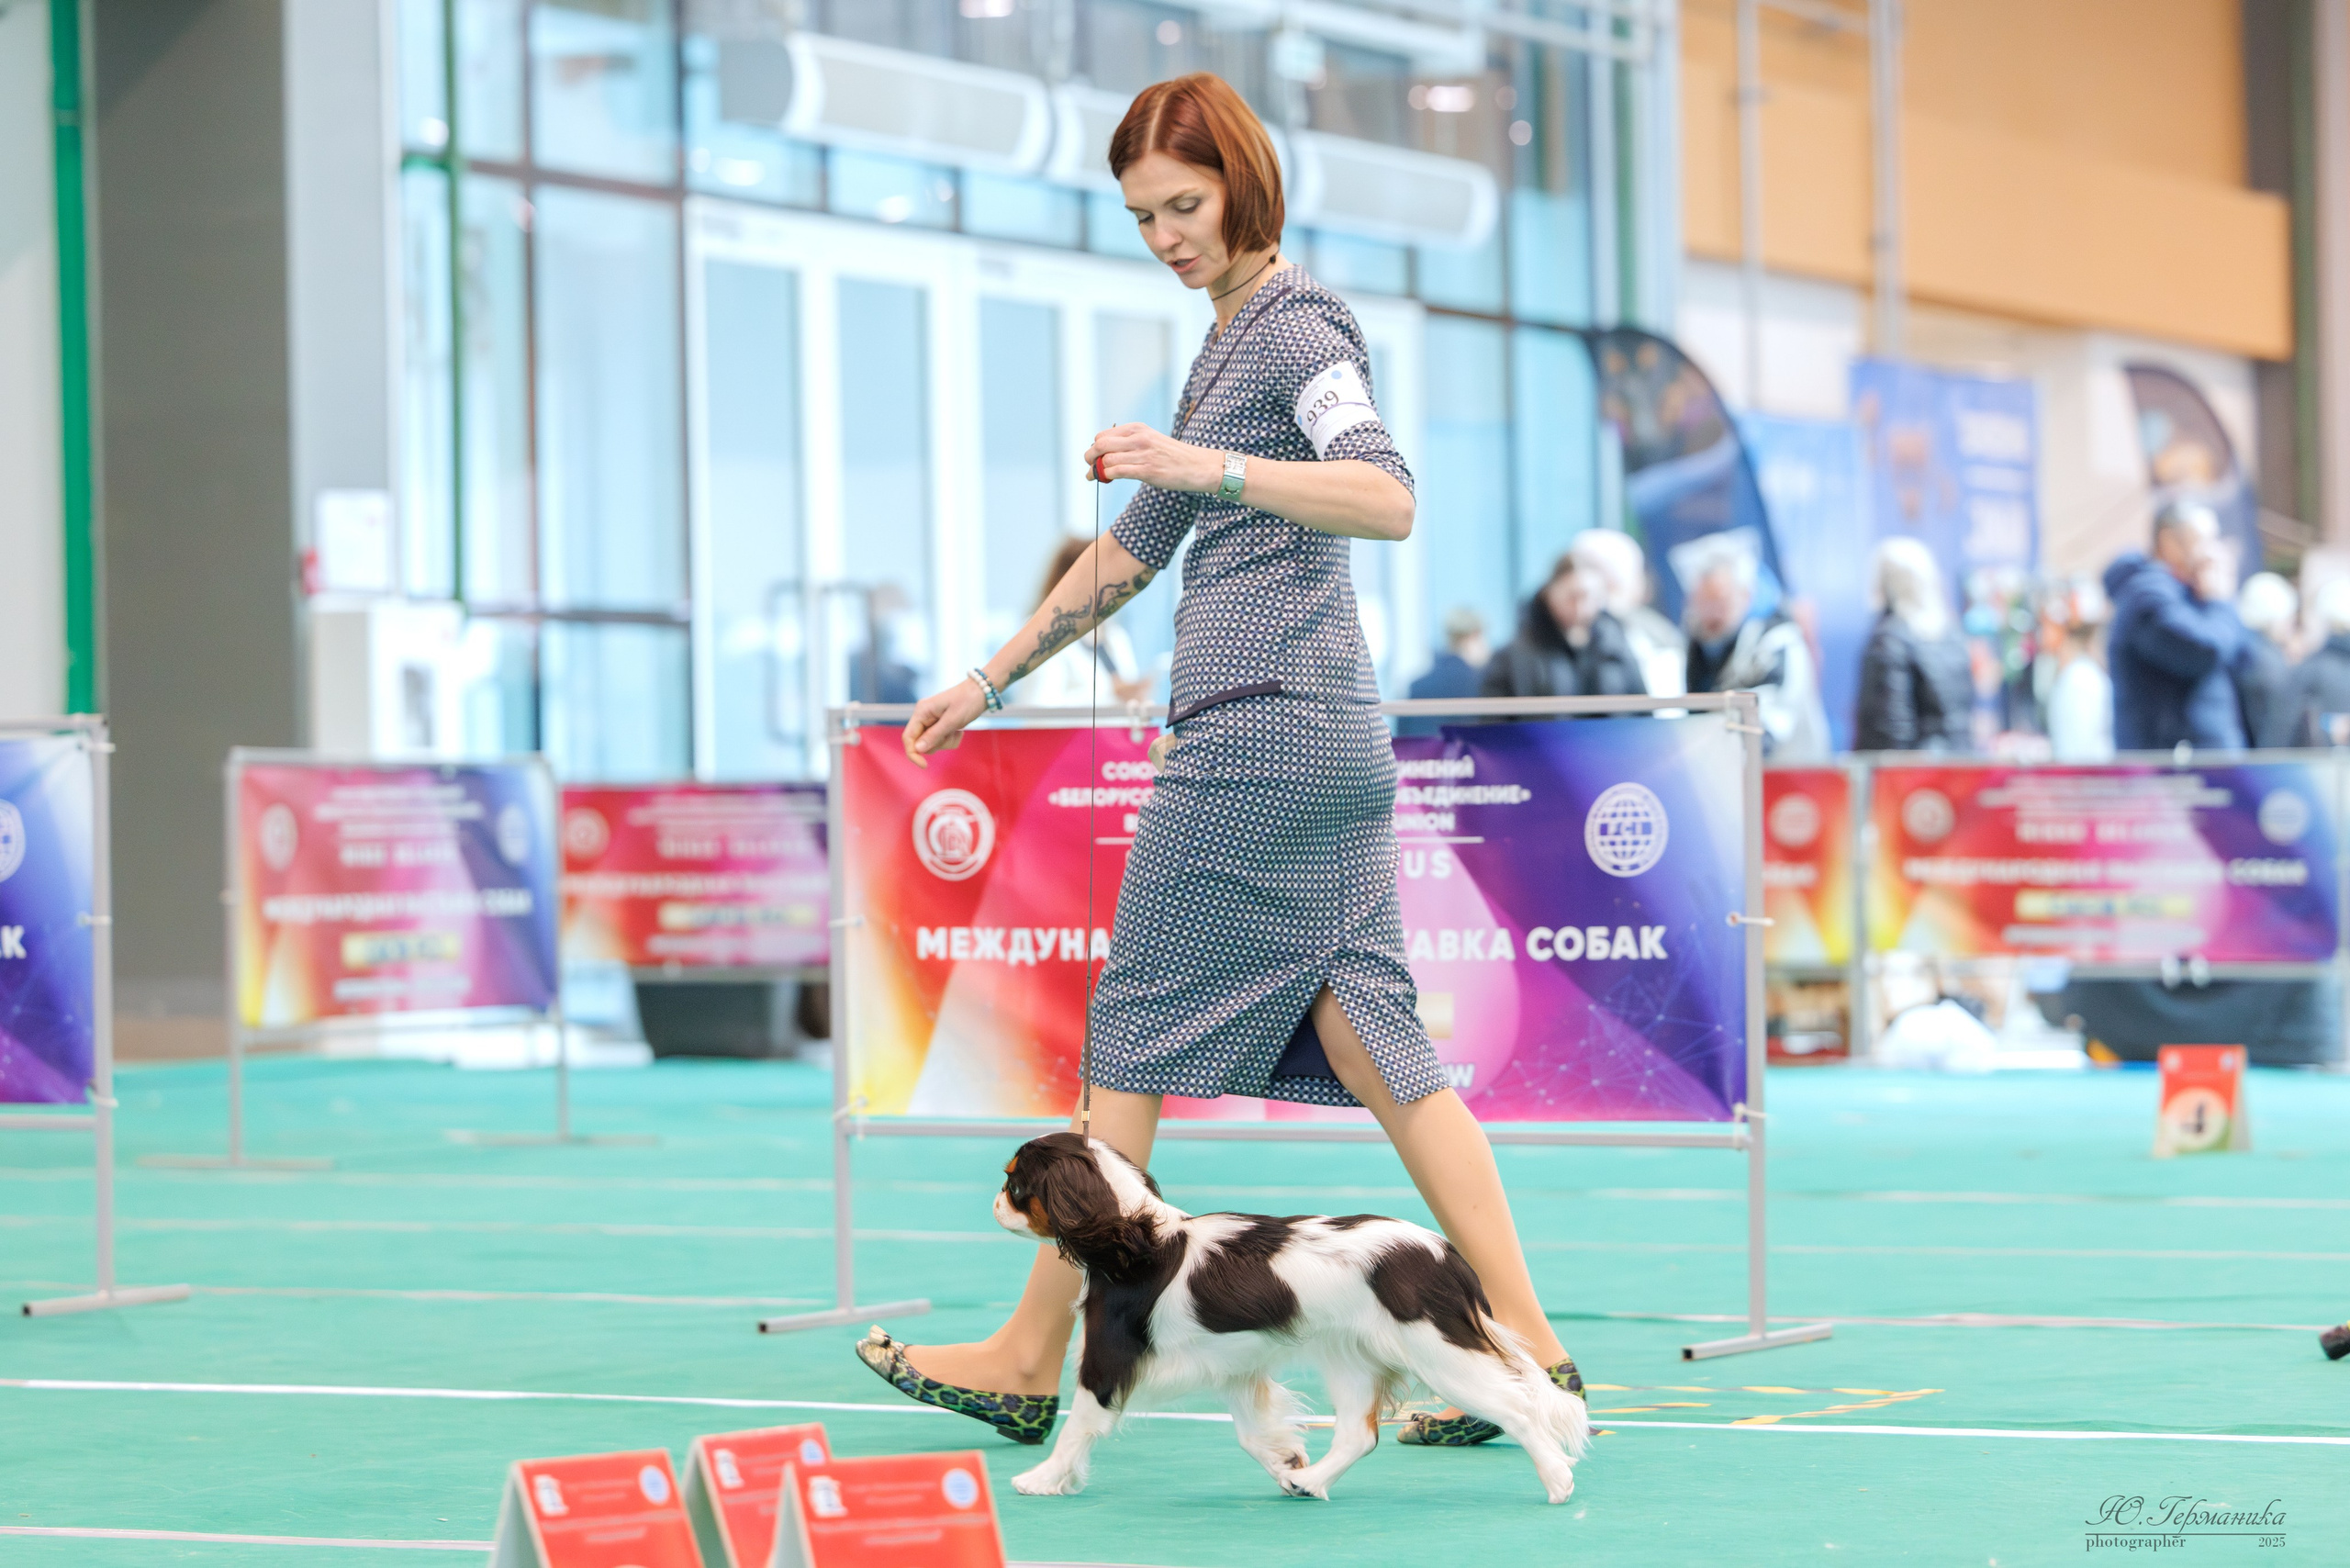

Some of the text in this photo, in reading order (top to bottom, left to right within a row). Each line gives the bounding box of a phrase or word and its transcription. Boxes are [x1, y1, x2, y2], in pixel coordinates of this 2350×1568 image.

[1306, 390, 1339, 422] 939
[1396, 784, 1532, 808] БЪЕДИНЕНИЕ»
[0, 924, 28, 959] К
[916, 925, 1668, 966] МЕЖДУНА АВКА СОБАК
